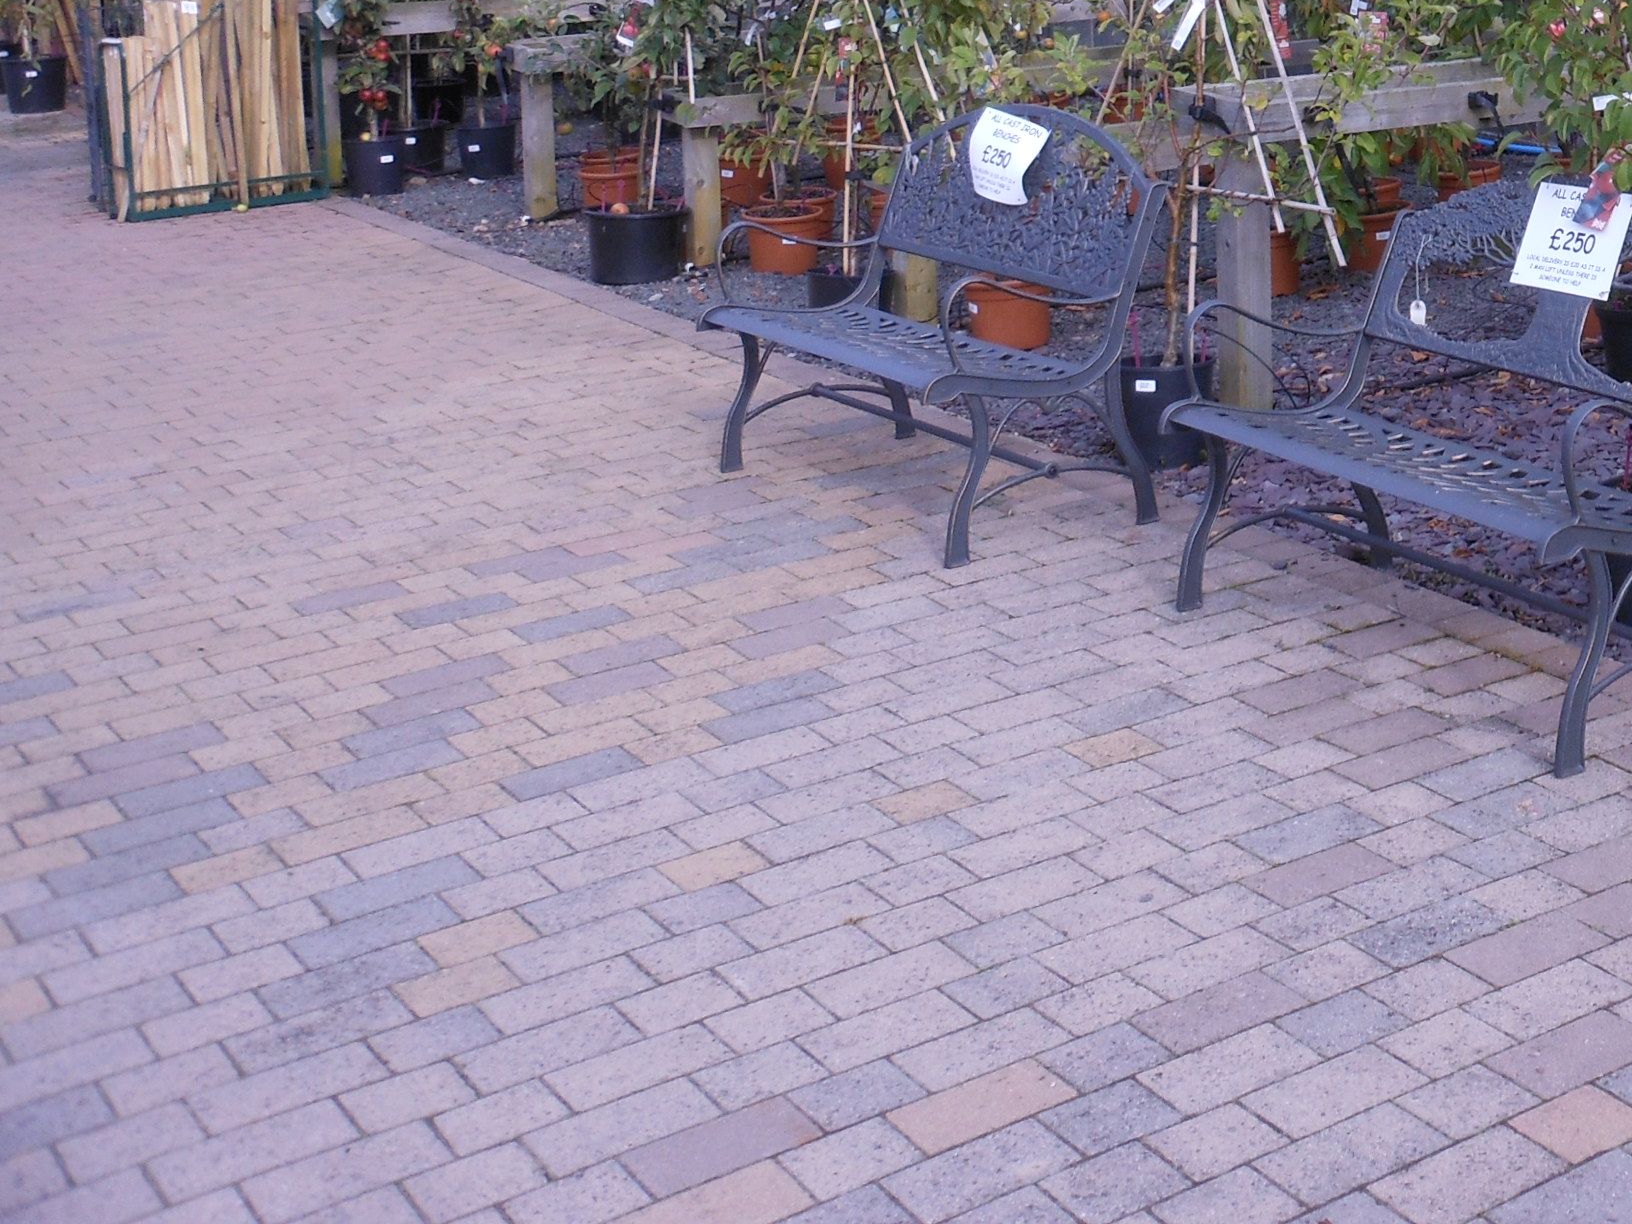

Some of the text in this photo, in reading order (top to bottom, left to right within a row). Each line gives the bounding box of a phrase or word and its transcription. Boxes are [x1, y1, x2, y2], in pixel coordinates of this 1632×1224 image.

[1003, 117, 1022, 128] CAST
[1020, 124, 1043, 138] IRON
[982, 144, 1012, 169] £250
[1552, 188, 1586, 202] ALL CAS
[1549, 228, 1596, 255] £250
